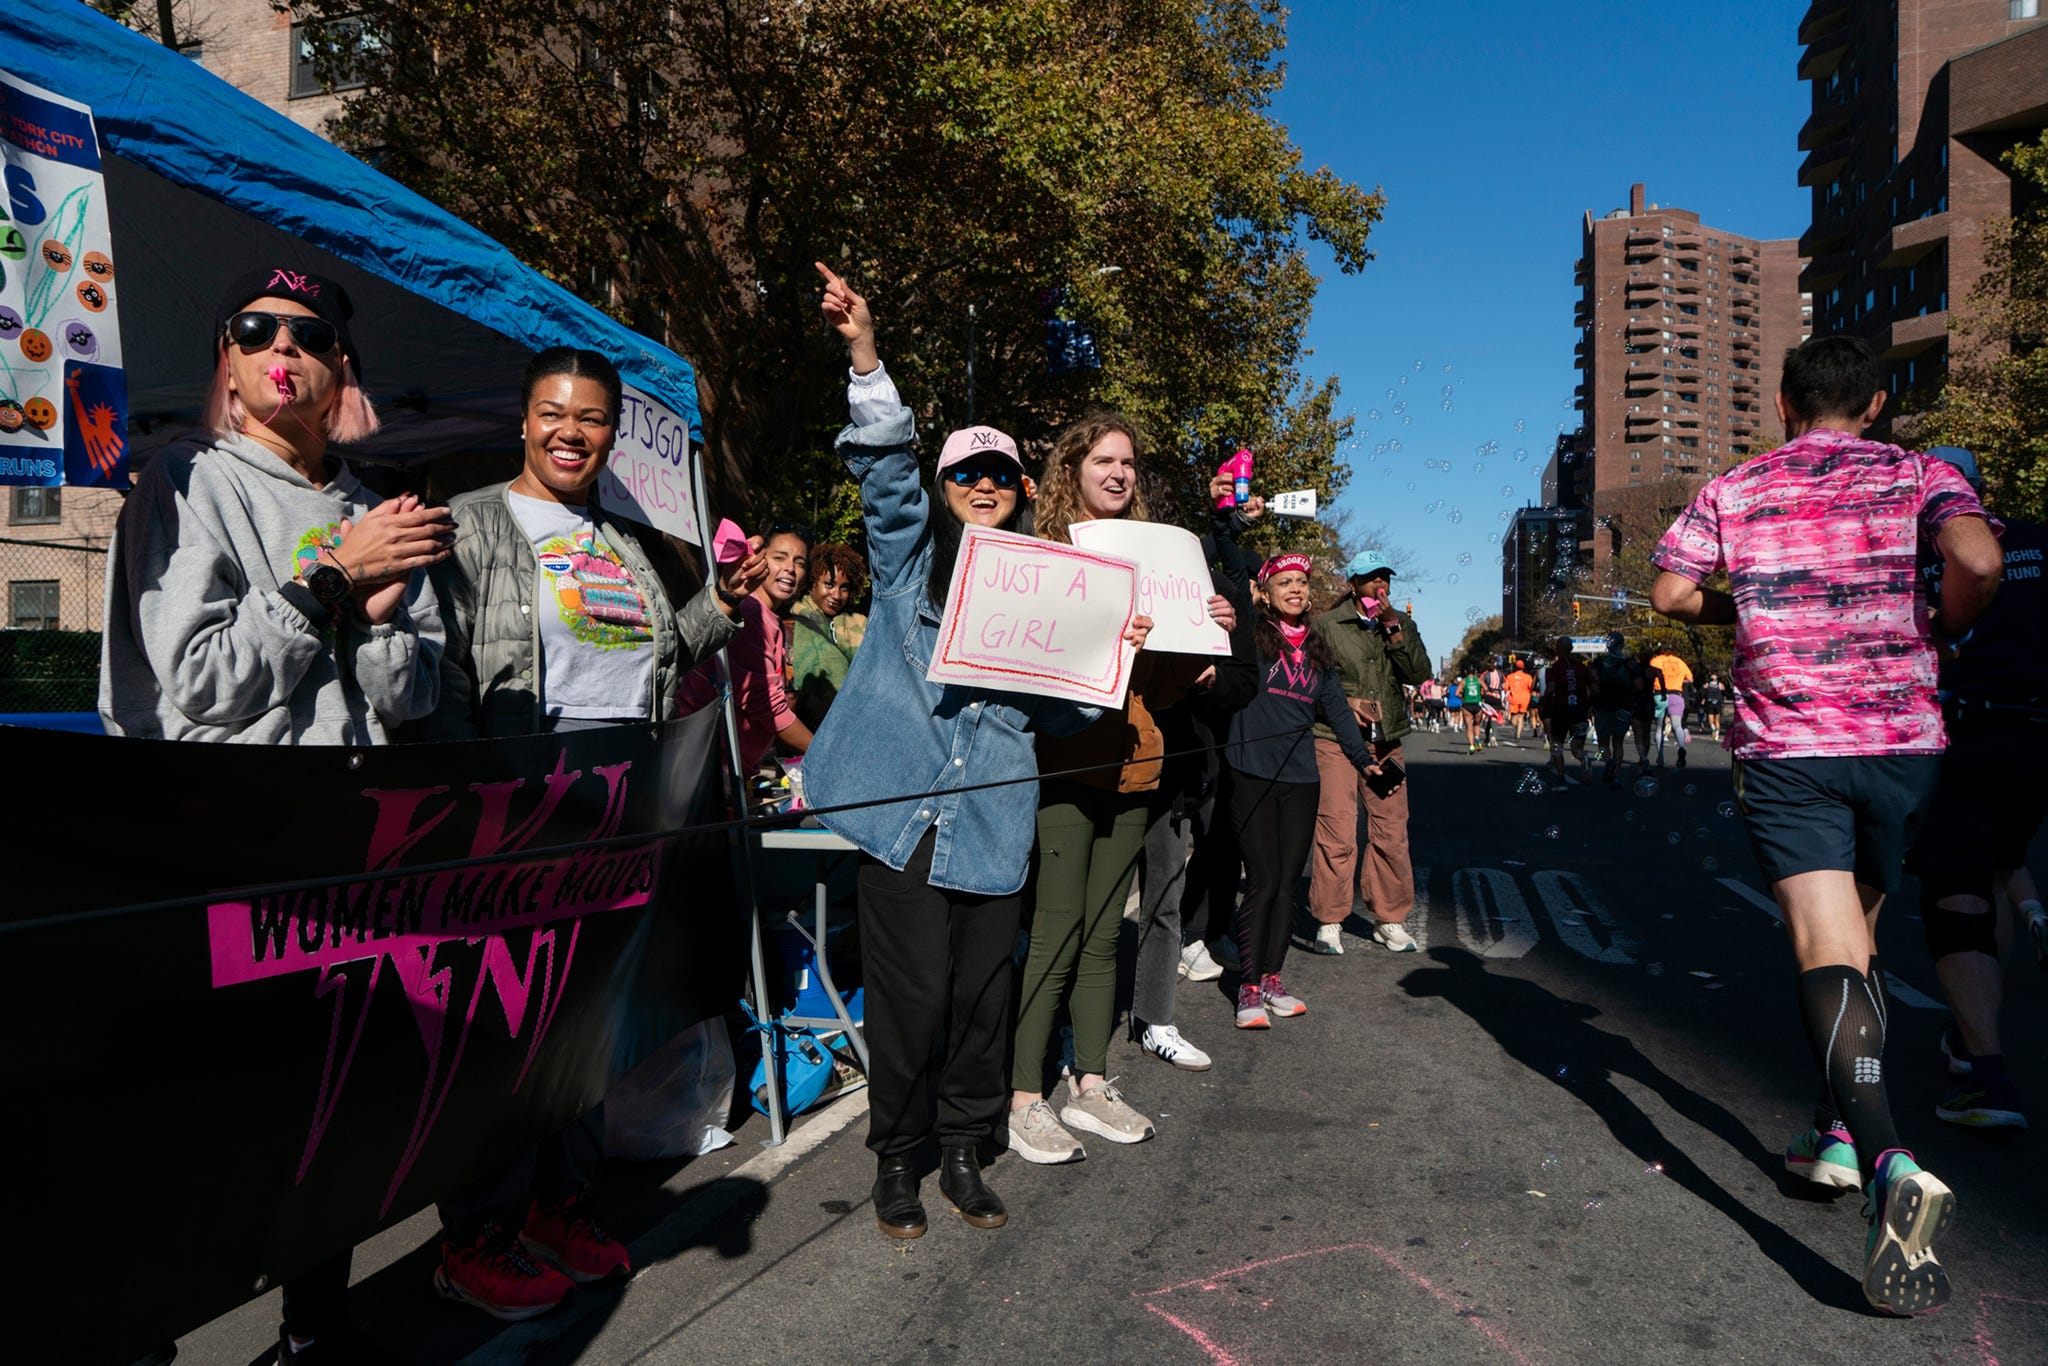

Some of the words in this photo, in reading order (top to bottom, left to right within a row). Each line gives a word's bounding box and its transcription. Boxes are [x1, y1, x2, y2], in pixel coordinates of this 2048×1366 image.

[11, 115, 48, 140] YORK
[50, 130, 84, 149] CITY
[617, 393, 654, 450] ET'S
[655, 416, 683, 467] GO
[0, 458, 57, 478] RUNS
[610, 450, 678, 514] GIRLS
[1922, 564, 1941, 579] PC
[2006, 566, 2041, 581] FUND
[2004, 549, 2043, 563] UGHES
[984, 557, 1049, 595] JUST
[1066, 567, 1087, 601] A
[1140, 569, 1204, 626] giving
[981, 613, 1064, 653] GIRL
[250, 874, 437, 963] WOMEN
[440, 865, 556, 929] MAKE
[553, 854, 656, 908] MOVES
